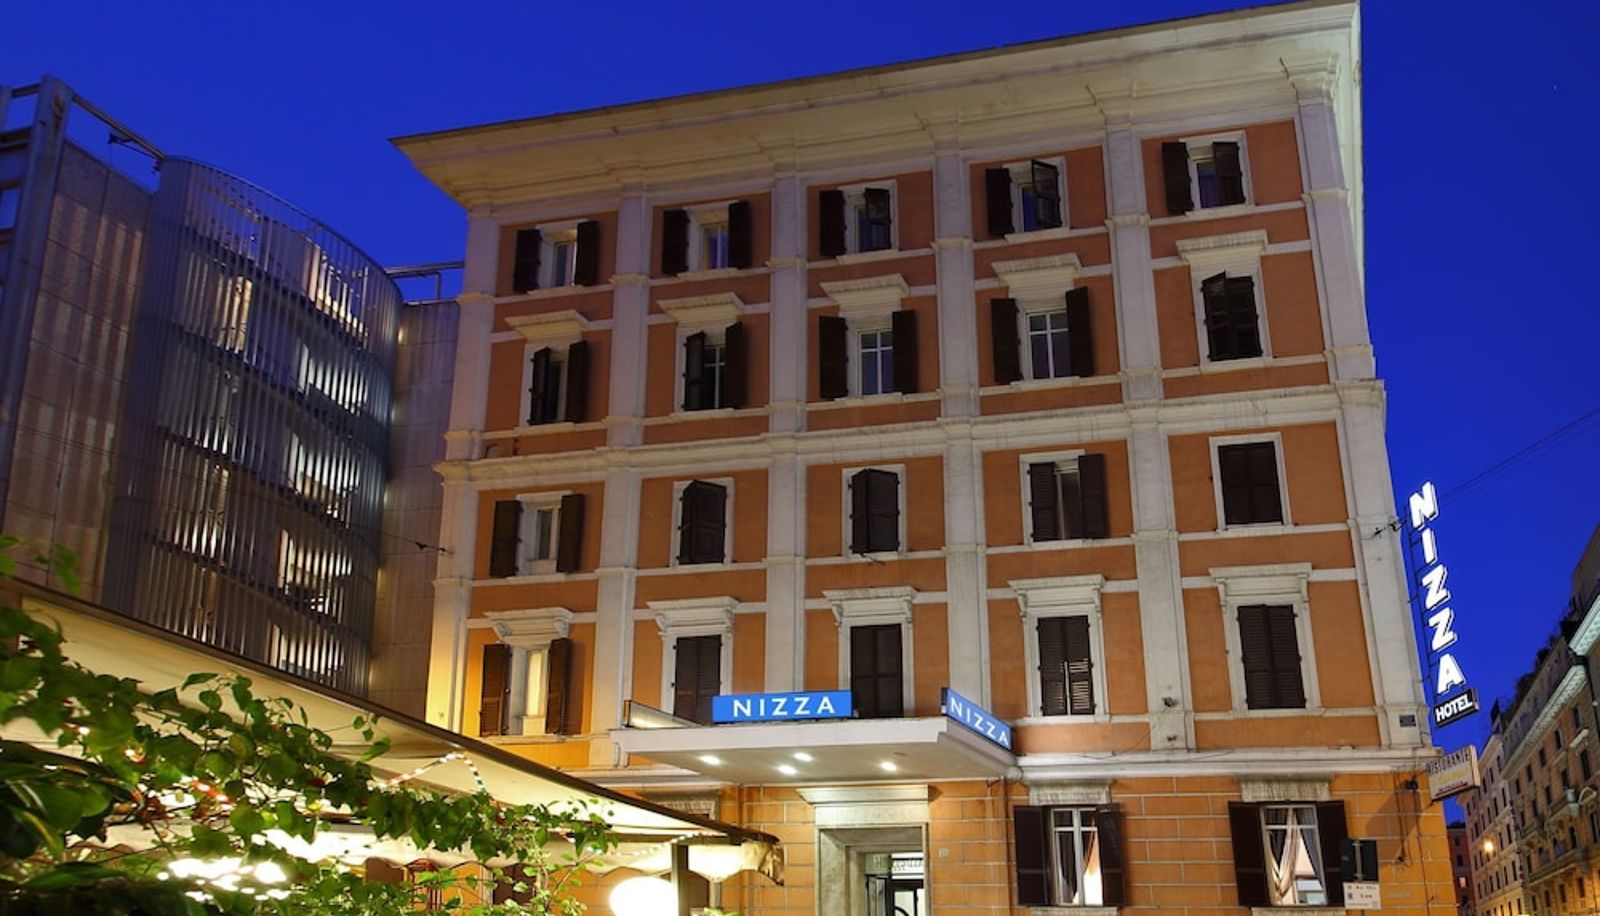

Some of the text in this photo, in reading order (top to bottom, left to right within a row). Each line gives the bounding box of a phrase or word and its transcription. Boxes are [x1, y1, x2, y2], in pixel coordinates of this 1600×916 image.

[1410, 482, 1465, 693] NIZZA
[733, 696, 835, 717] NIZZA
[950, 697, 1008, 745] NIZZA
[1435, 694, 1473, 722] HOTEL
